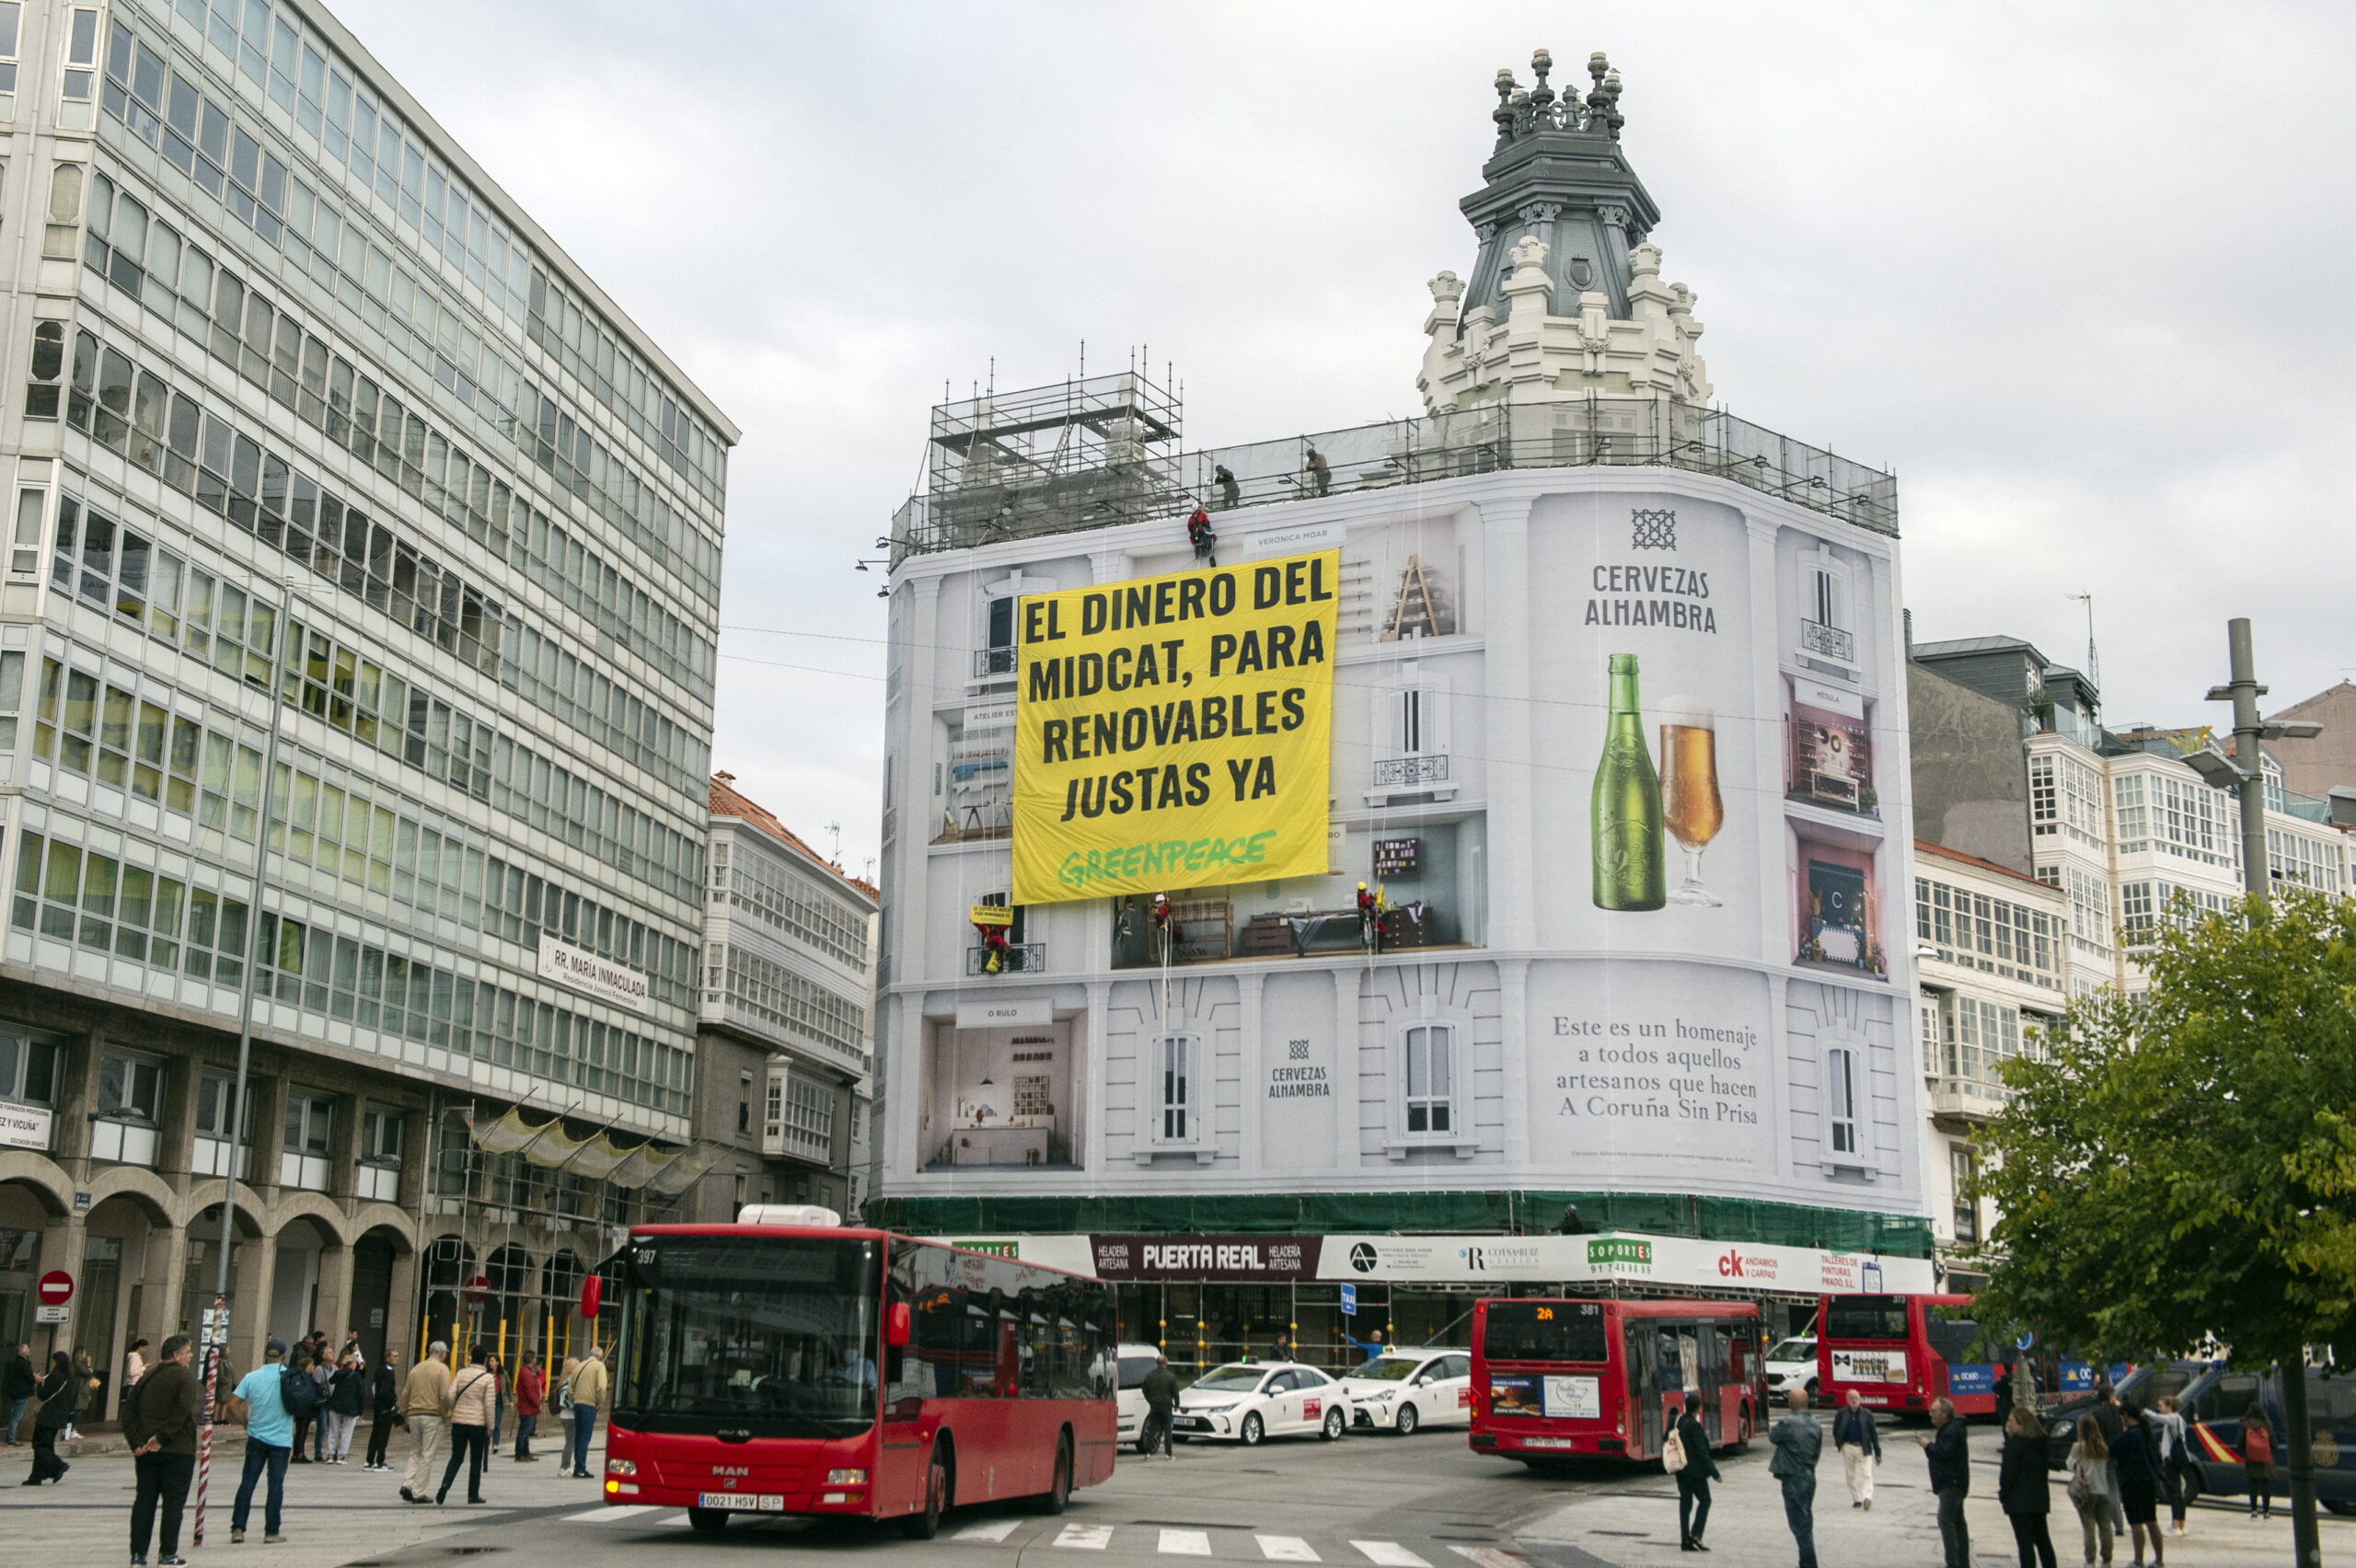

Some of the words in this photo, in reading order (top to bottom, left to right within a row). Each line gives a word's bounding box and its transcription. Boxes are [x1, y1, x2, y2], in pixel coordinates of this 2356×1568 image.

[1258, 534, 1301, 546] VERÓNICA
[1302, 530, 1328, 539] MOAR
[1593, 564, 1710, 599] CERVEZAS
[1025, 599, 1067, 644] EL
[1081, 572, 1237, 637] DINERO
[1253, 558, 1333, 611] DEL
[1585, 599, 1717, 634] ALHAMBRA
[1028, 639, 1194, 704] MIDCAT,
[1210, 620, 1325, 677] PARA
[973, 711, 1004, 720] ATELIER
[1043, 686, 1306, 765] RENOVABLES
[1060, 761, 1211, 823] JUSTAS
[1227, 755, 1276, 801] YA
[1057, 828, 1277, 889] GREENPEACE
[554, 950, 569, 969] RR.
[571, 955, 597, 979] MARÍA
[598, 966, 646, 998] INMACULADA
[562, 972, 594, 991] Residencia
[594, 985, 612, 998] Juvenil
[612, 991, 638, 1007] Femenina
[987, 1009, 994, 1018] O
[996, 1009, 1018, 1017] RULO
[1553, 1016, 1602, 1036] Este
[1610, 1022, 1630, 1037] es
[1638, 1022, 1668, 1039] un
[1675, 1018, 1758, 1051] homenaje
[1578, 1049, 1590, 1063] a
[1599, 1043, 1659, 1065] todos
[1667, 1047, 1741, 1073] aquellos
[1272, 1066, 1327, 1081] CERVEZAS
[1268, 1081, 1331, 1099] ALHAMBRA
[1556, 1072, 1661, 1091] artesanos
[1669, 1078, 1705, 1099] que
[1710, 1075, 1757, 1099] hacen
[1558, 1098, 1578, 1116] A
[1587, 1095, 1670, 1119] Coruña
[1678, 1099, 1710, 1121] Sin
[1715, 1102, 1758, 1125] Prisa
[7, 1118, 12, 1127] Y
[637, 1249, 656, 1265] 397
[1098, 1243, 1129, 1258] HELADERÍA
[1143, 1245, 1212, 1270] PUERTA
[1217, 1245, 1265, 1270] REAL
[1268, 1243, 1301, 1258] HELADERÍA
[1589, 1243, 1651, 1260] SOPORTES
[1098, 1258, 1129, 1270] ARTESANA
[1268, 1258, 1302, 1271] ARTESANA
[1718, 1249, 1744, 1277] ck
[1745, 1258, 1778, 1268] ANDAMIOS
[1820, 1255, 1849, 1267] TALLERES
[1850, 1258, 1858, 1267] DE
[1746, 1269, 1750, 1277] Y
[1751, 1269, 1776, 1279] CARPAS
[1821, 1266, 1851, 1277] PINTURAS
[1821, 1276, 1844, 1288] PRADO,
[1845, 1278, 1855, 1288] S.L.
[1342, 1292, 1356, 1304] TAXI
[1893, 1296, 1906, 1304] 373
[1536, 1307, 1553, 1320] 2A
[1581, 1304, 1599, 1315] 381
[712, 1466, 749, 1477] MAN
[706, 1495, 732, 1506] 0021
[734, 1496, 755, 1507] HSV
[762, 1497, 780, 1508] SP
